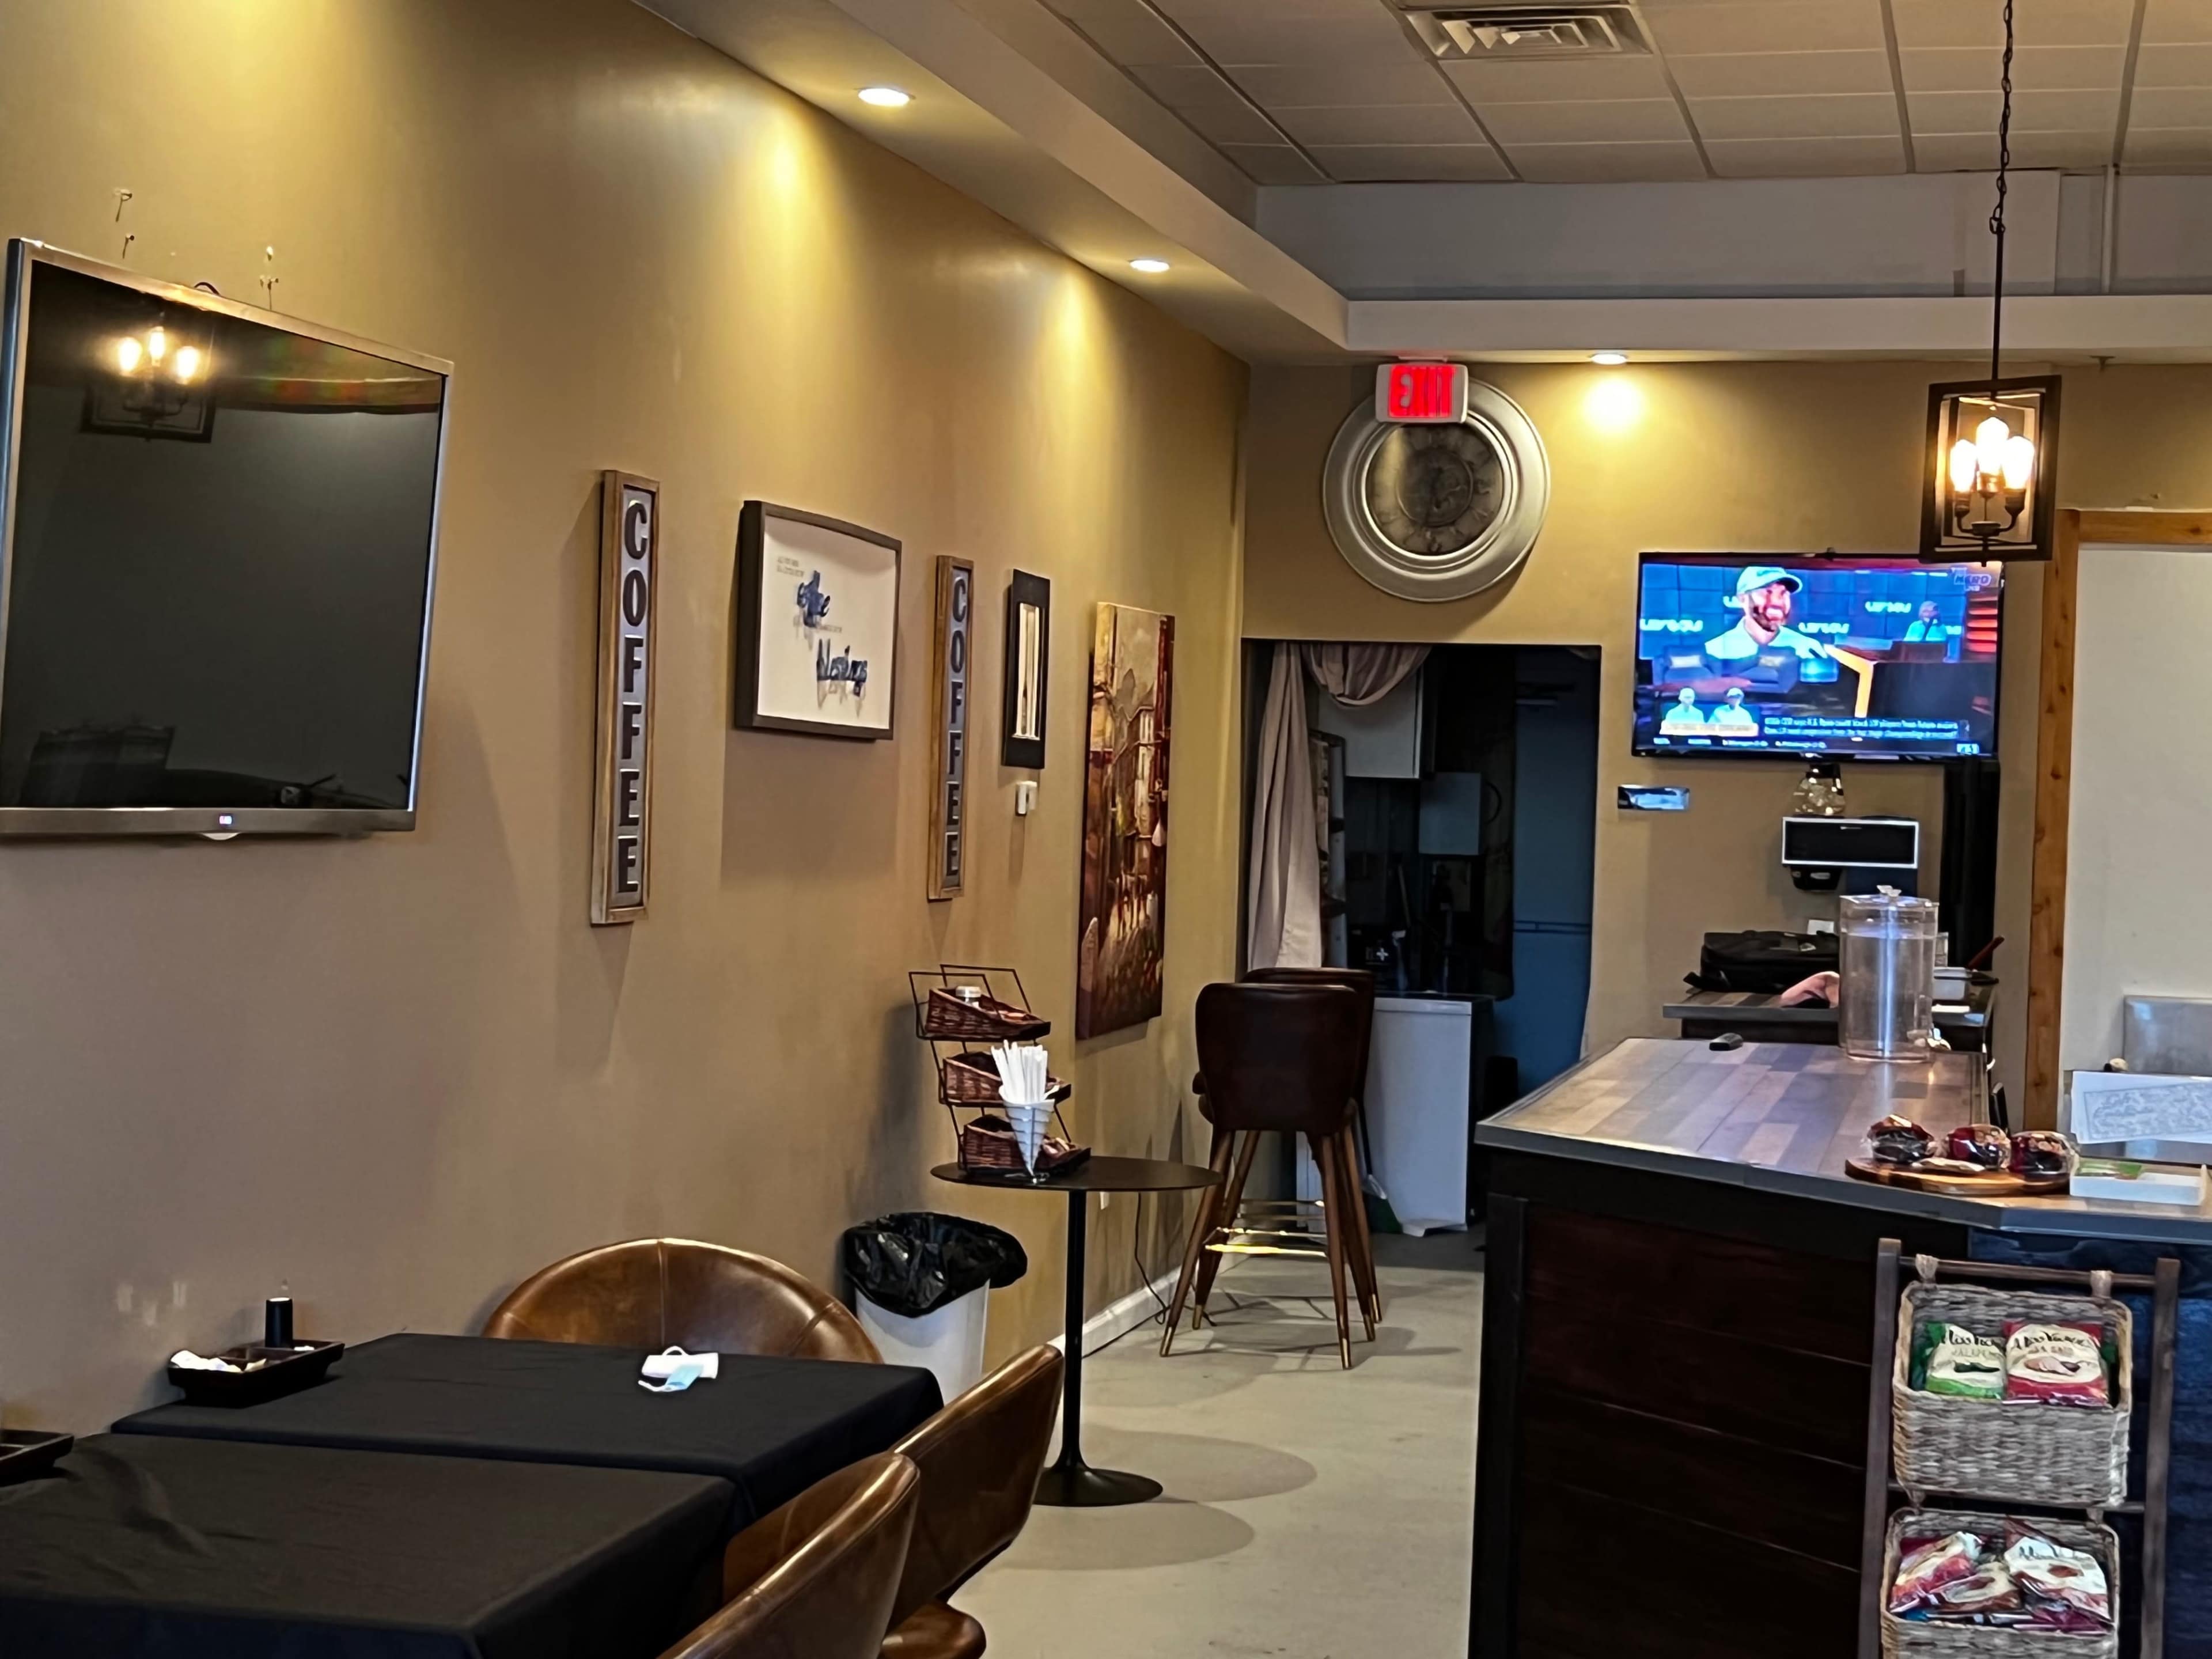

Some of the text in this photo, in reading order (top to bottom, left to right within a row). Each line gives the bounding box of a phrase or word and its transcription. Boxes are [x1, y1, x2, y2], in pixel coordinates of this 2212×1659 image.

[1388, 364, 1457, 419] EXIT
[618, 500, 649, 893] COFFEE
[945, 577, 967, 876] COFFEE
